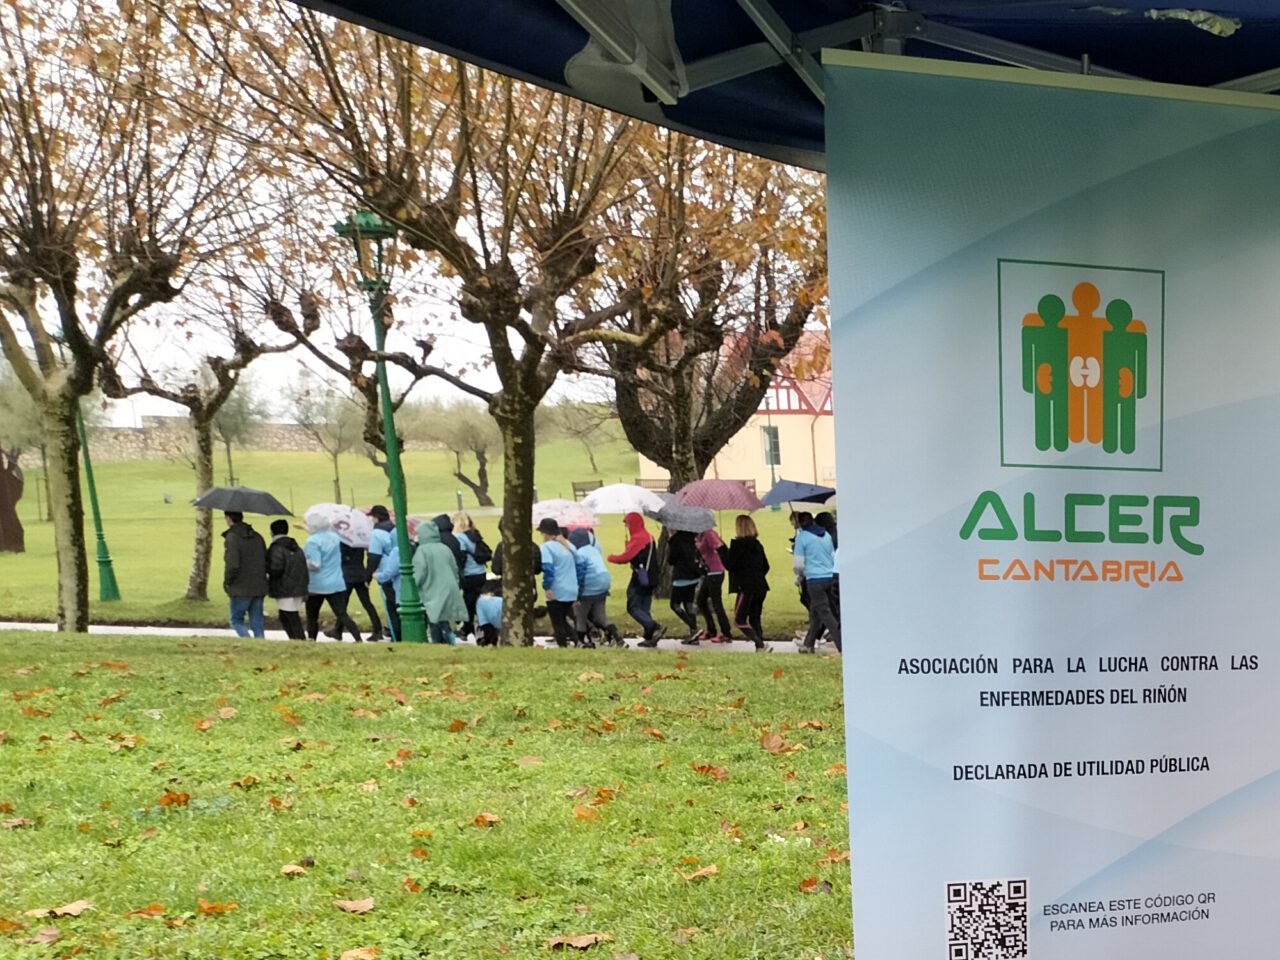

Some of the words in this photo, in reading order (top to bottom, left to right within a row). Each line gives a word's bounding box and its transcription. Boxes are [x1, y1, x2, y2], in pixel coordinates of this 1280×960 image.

[959, 491, 1205, 556] ALCER
[978, 559, 1184, 588] CANTABRIA
[898, 654, 998, 674] ASOCIACIÓN
[1012, 657, 1054, 674] PARA
[1067, 656, 1086, 673] LA
[1099, 656, 1148, 673] LUCHA
[1161, 655, 1218, 672] CONTRA
[1231, 655, 1258, 671] LAS
[980, 689, 1105, 707] ENFERMEDADES
[1110, 688, 1138, 705] DEL
[1142, 684, 1187, 704] RIÑÓN
[953, 762, 1048, 781] DECLARADA
[1053, 762, 1072, 777] DE
[1077, 759, 1145, 777] UTILIDAD
[1150, 754, 1209, 774] PÚBLICA
[1043, 901, 1104, 916] ESCANEA
[1109, 899, 1140, 913] ESTE
[1145, 893, 1194, 909] CÓDIGO
[1198, 893, 1215, 905] QR
[1050, 918, 1085, 932] PARA
[1089, 913, 1117, 928] MÁS
[1121, 908, 1209, 927] INFORMACIÓN
